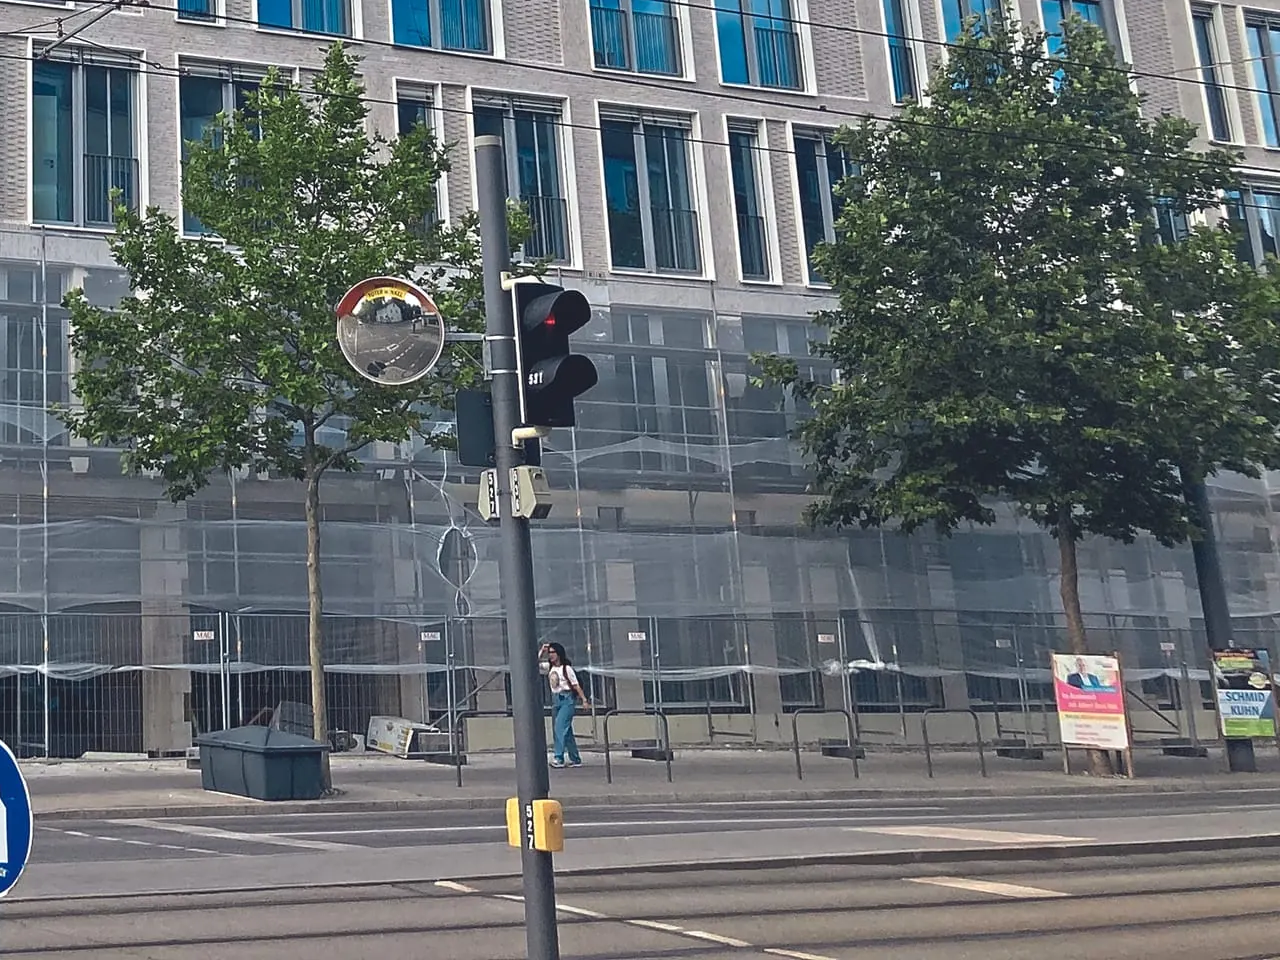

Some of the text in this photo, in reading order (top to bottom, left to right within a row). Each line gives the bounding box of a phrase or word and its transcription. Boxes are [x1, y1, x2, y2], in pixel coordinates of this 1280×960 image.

[1225, 692, 1265, 702] SCHMID
[1230, 705, 1260, 716] KUHN
[526, 805, 534, 850] 527
